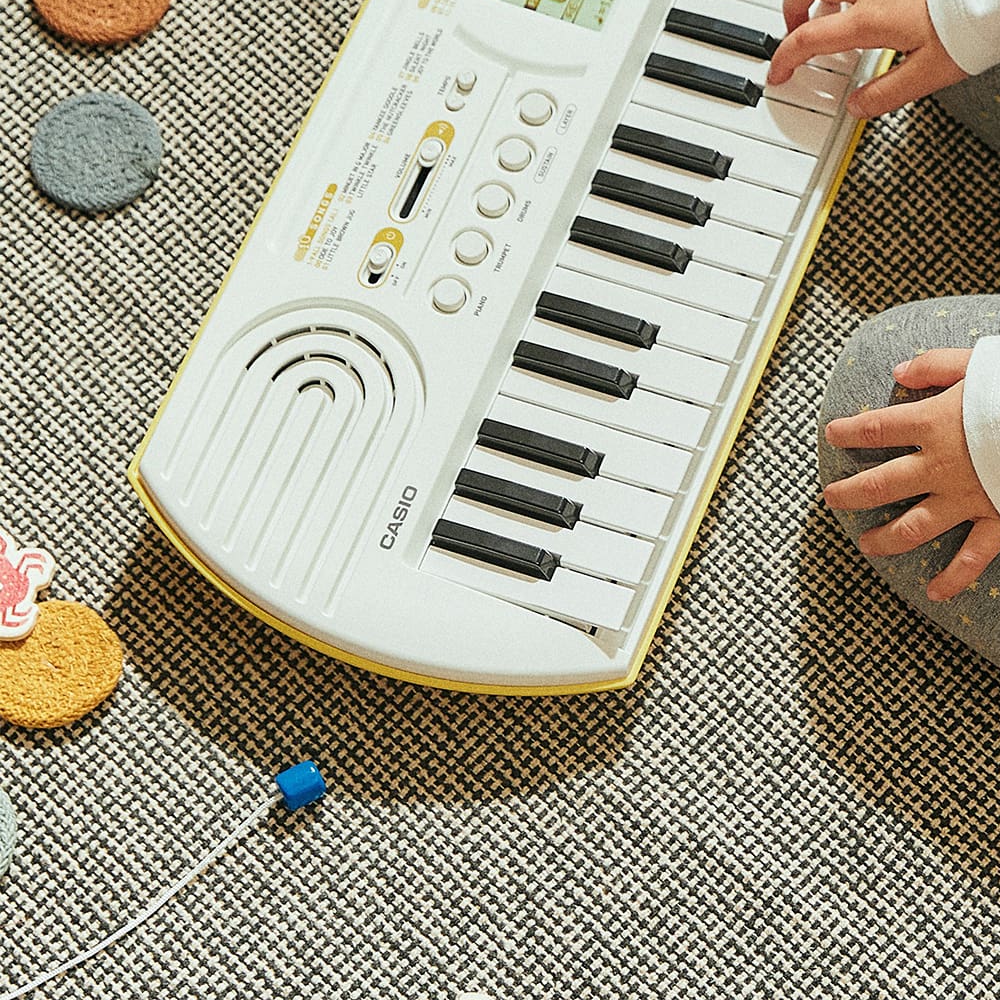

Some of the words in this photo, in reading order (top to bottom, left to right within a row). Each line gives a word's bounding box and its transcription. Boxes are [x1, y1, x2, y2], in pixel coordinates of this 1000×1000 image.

[378, 121, 389, 134] THE
[559, 108, 573, 129] LAYER
[348, 170, 365, 196] TWINKLE
[361, 144, 378, 170] TWINKLE
[394, 152, 411, 179] VOLUME
[536, 150, 554, 178] SUSTAIN
[356, 178, 370, 199] LITTLE
[308, 189, 334, 231] SONGS
[516, 198, 532, 222] DRUMS
[318, 246, 328, 260] ODE
[326, 242, 339, 263] LITTLE
[335, 220, 350, 242] BROWN
[492, 242, 512, 273] TRUMPET
[473, 294, 488, 317] PIANO
[377, 483, 420, 551] CASIO
